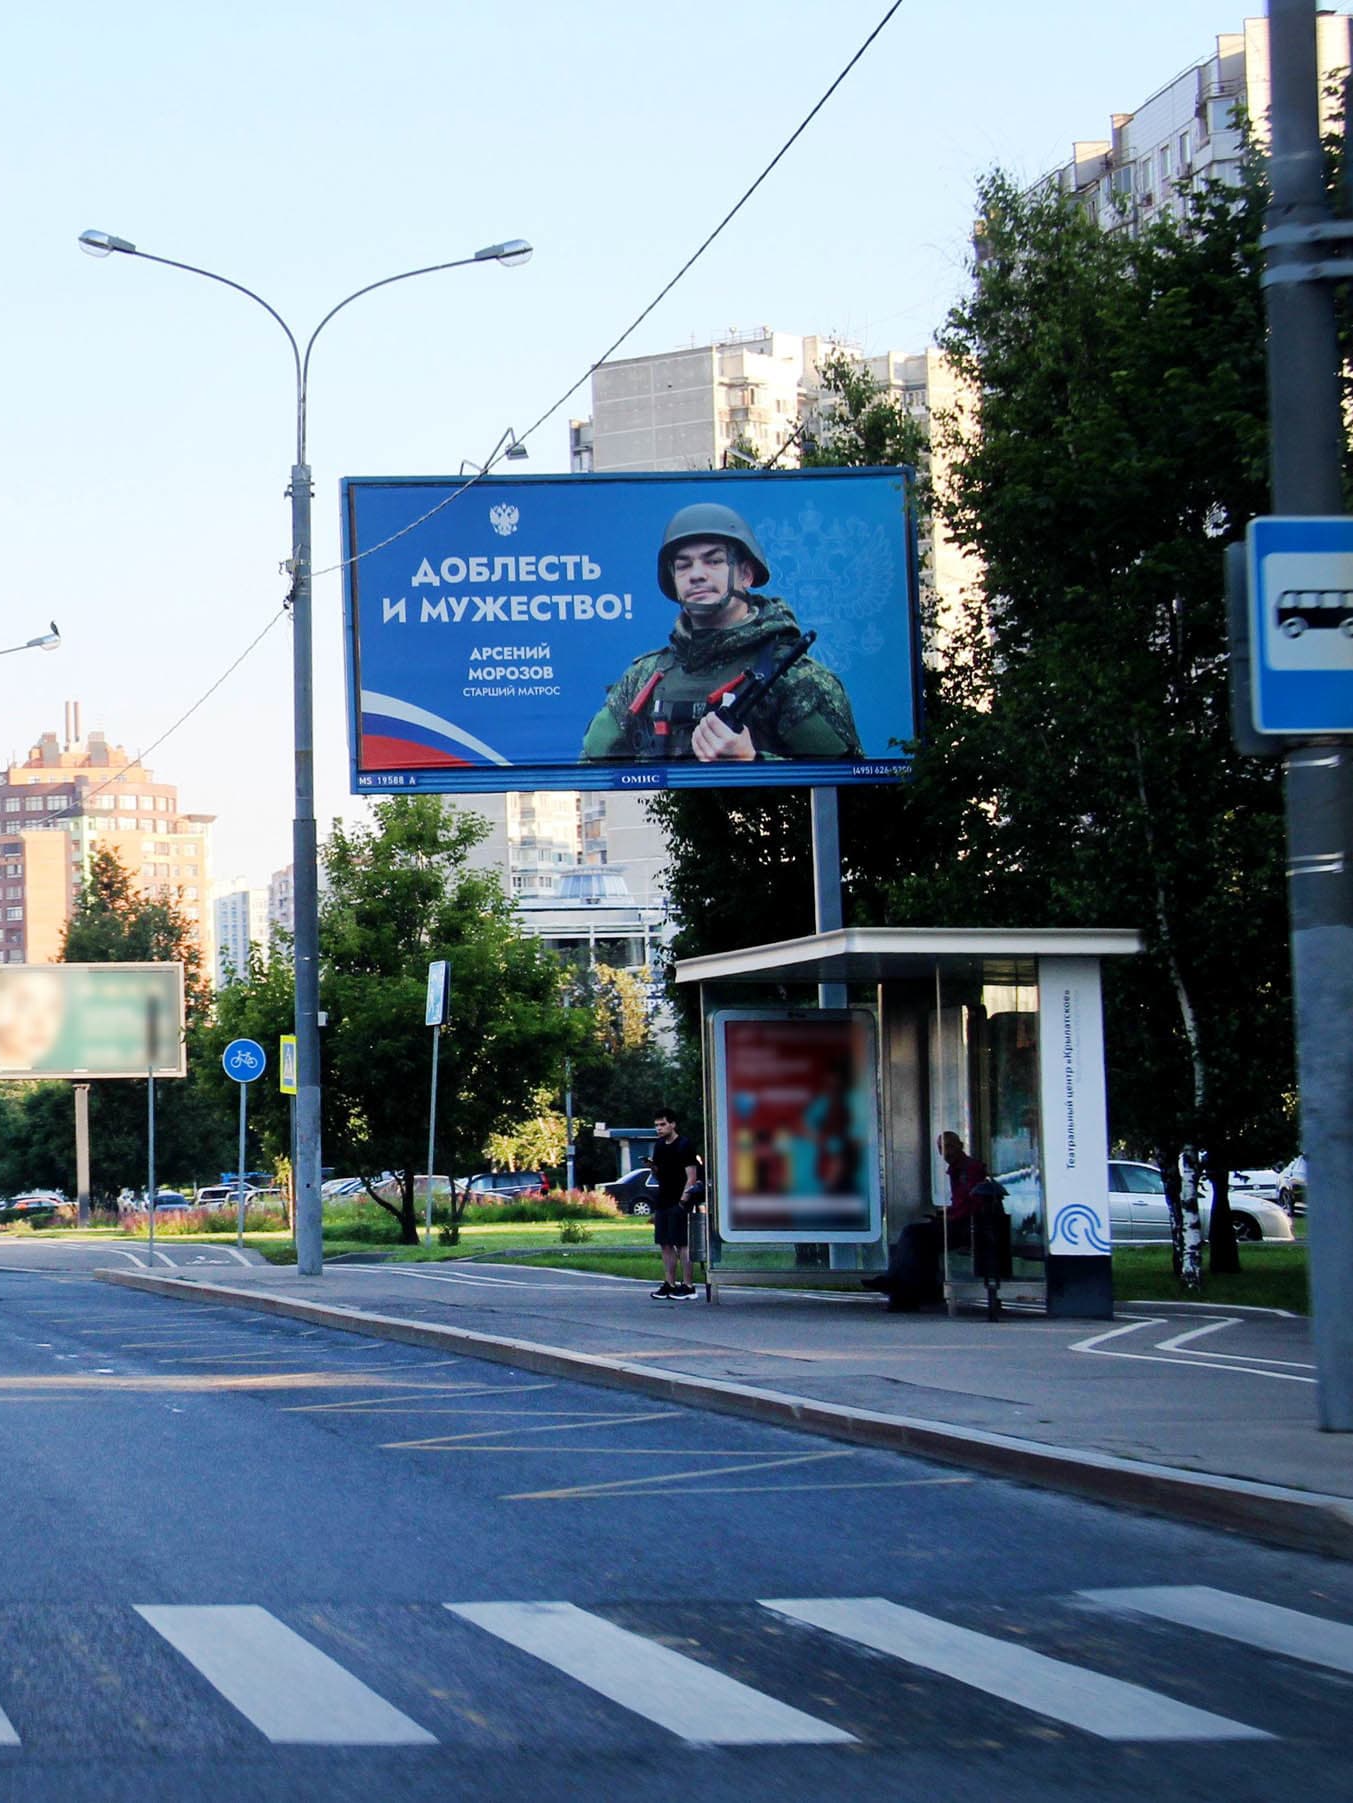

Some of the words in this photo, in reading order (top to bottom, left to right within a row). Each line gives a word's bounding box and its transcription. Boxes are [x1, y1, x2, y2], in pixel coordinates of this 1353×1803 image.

[411, 555, 602, 587] ДОБЛЕСТЬ
[382, 597, 407, 624] И
[420, 593, 633, 623] МУЖЕСТВО!
[469, 642, 551, 661] АРСЕНИЙ
[468, 666, 554, 681] МОРОЗОВ
[462, 685, 516, 697] СТАРШИЙ
[517, 686, 561, 696] МАТРОС
[621, 774, 660, 784] ОМИС
[852, 765, 873, 776] (495)
[359, 776, 373, 785] MS
[409, 775, 417, 785] A
[1064, 1067, 1074, 1098] центр
[1066, 1100, 1076, 1169] Театральный
